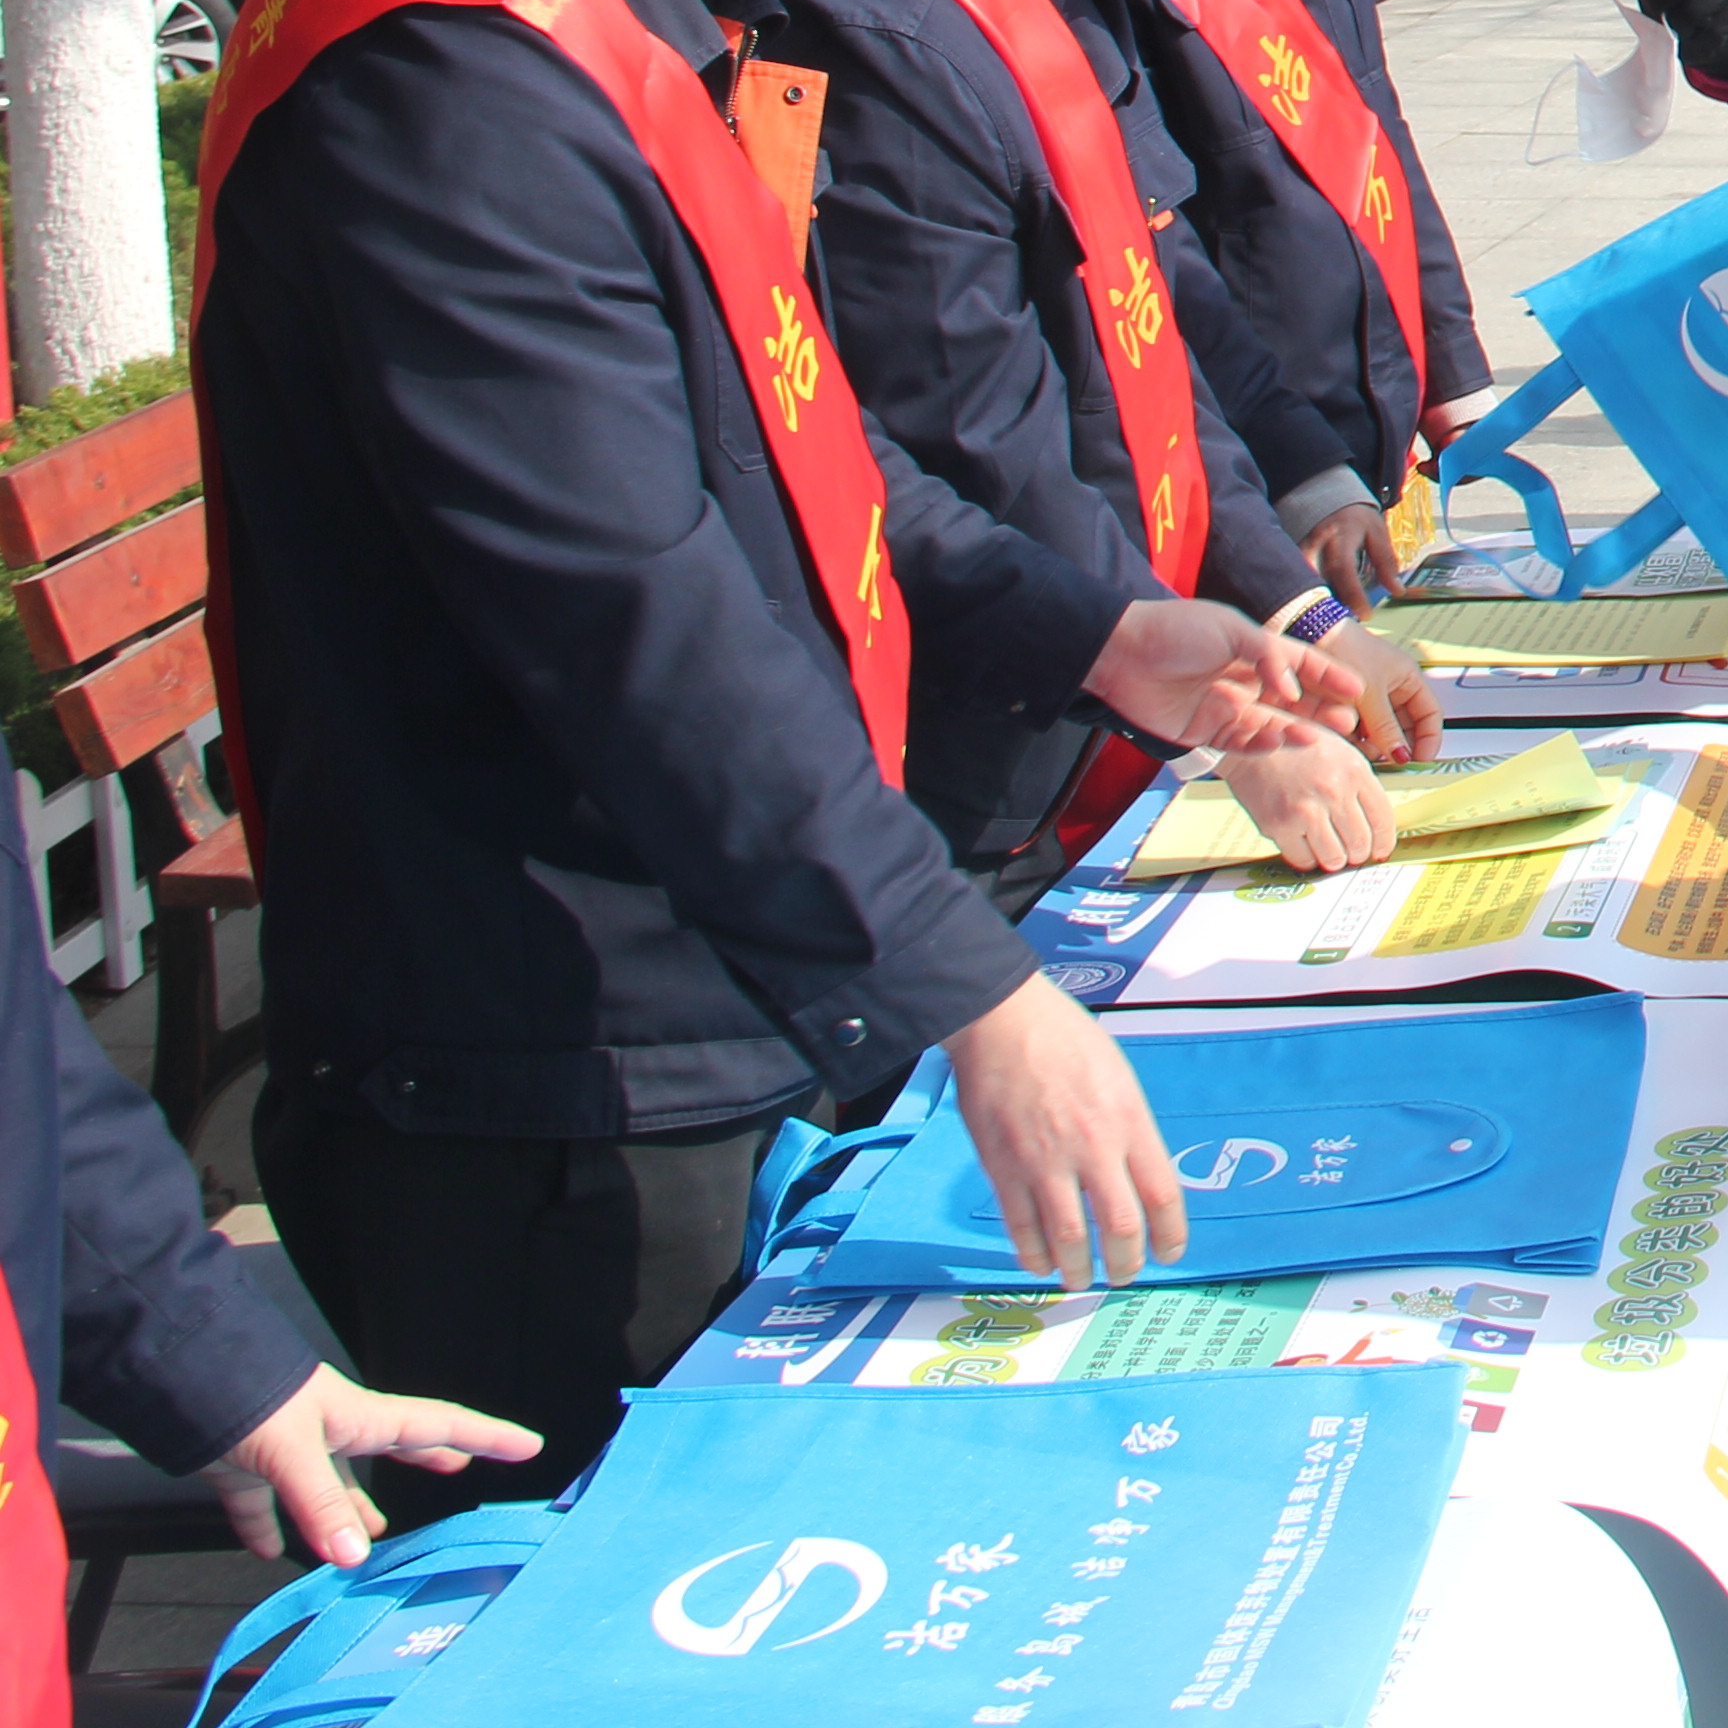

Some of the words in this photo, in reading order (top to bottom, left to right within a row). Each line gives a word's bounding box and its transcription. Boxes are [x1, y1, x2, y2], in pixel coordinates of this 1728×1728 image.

[1296, 1131, 1361, 1190] 洁万家
[883, 1530, 1018, 1658] 洁万家
[1169, 1414, 1347, 1710] 青岛市固体废弃物处置有限责任公司
